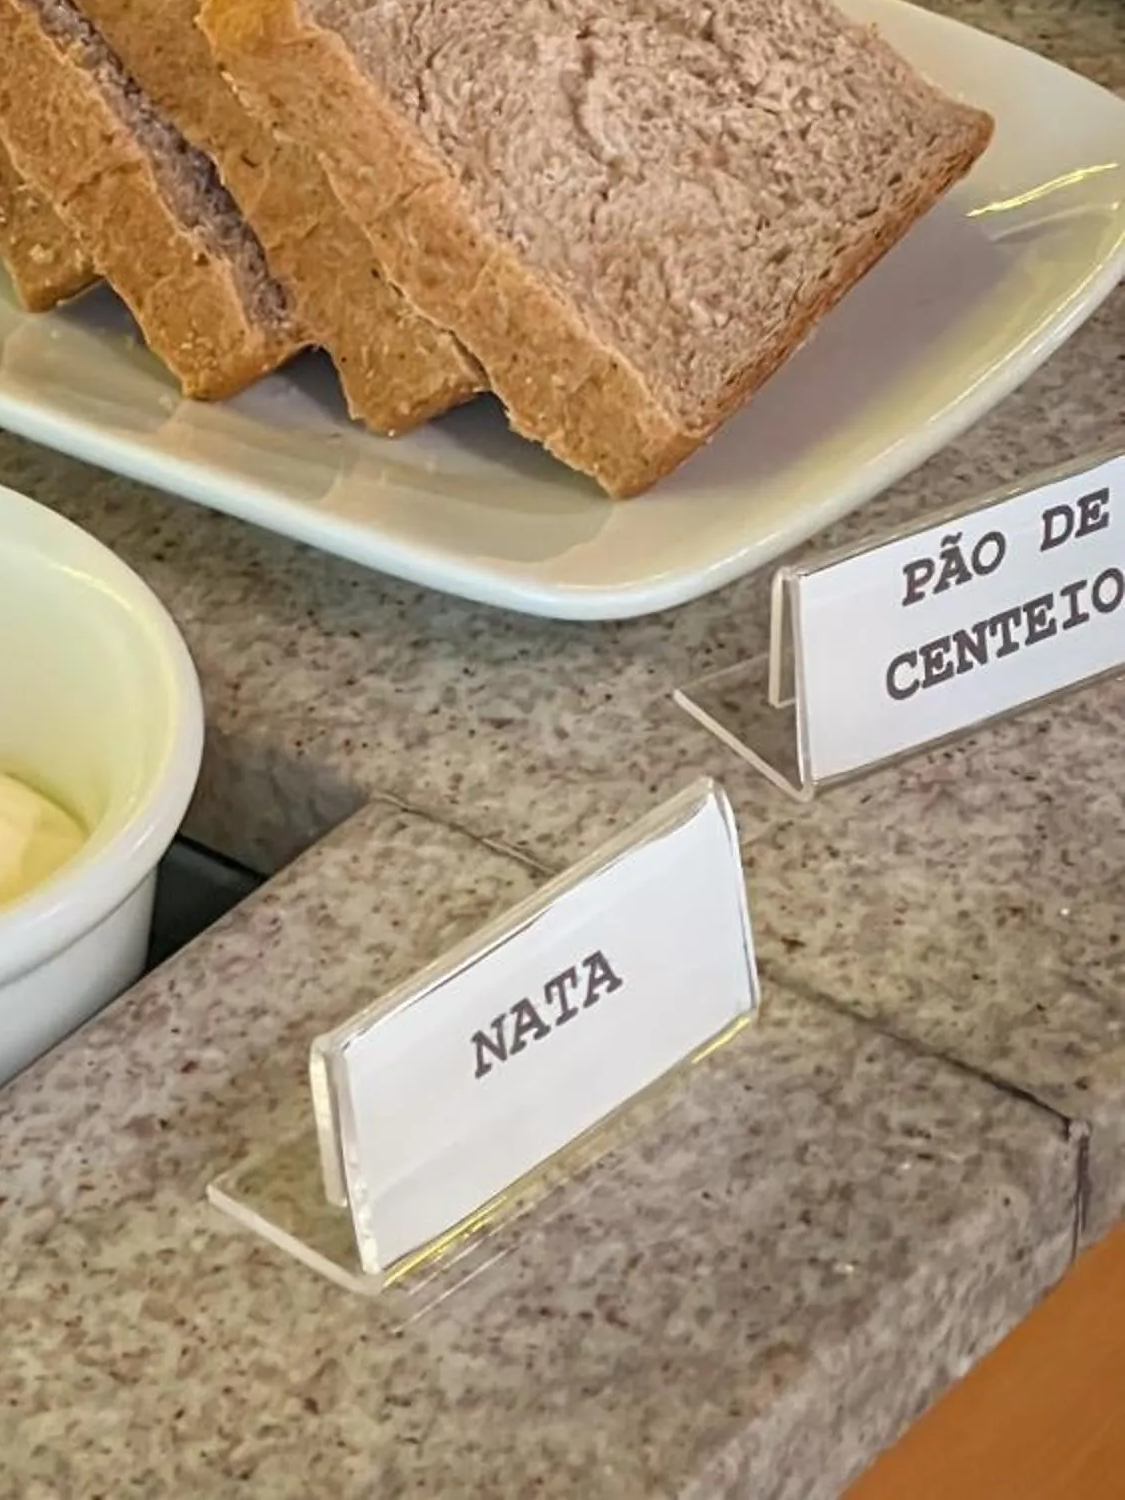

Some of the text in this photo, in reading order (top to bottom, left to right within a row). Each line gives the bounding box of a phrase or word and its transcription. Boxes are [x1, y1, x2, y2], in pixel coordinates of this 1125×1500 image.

[902, 487, 1110, 607] PÃO DE
[886, 567, 1125, 700] CENTEIO
[470, 950, 624, 1079] NATA
